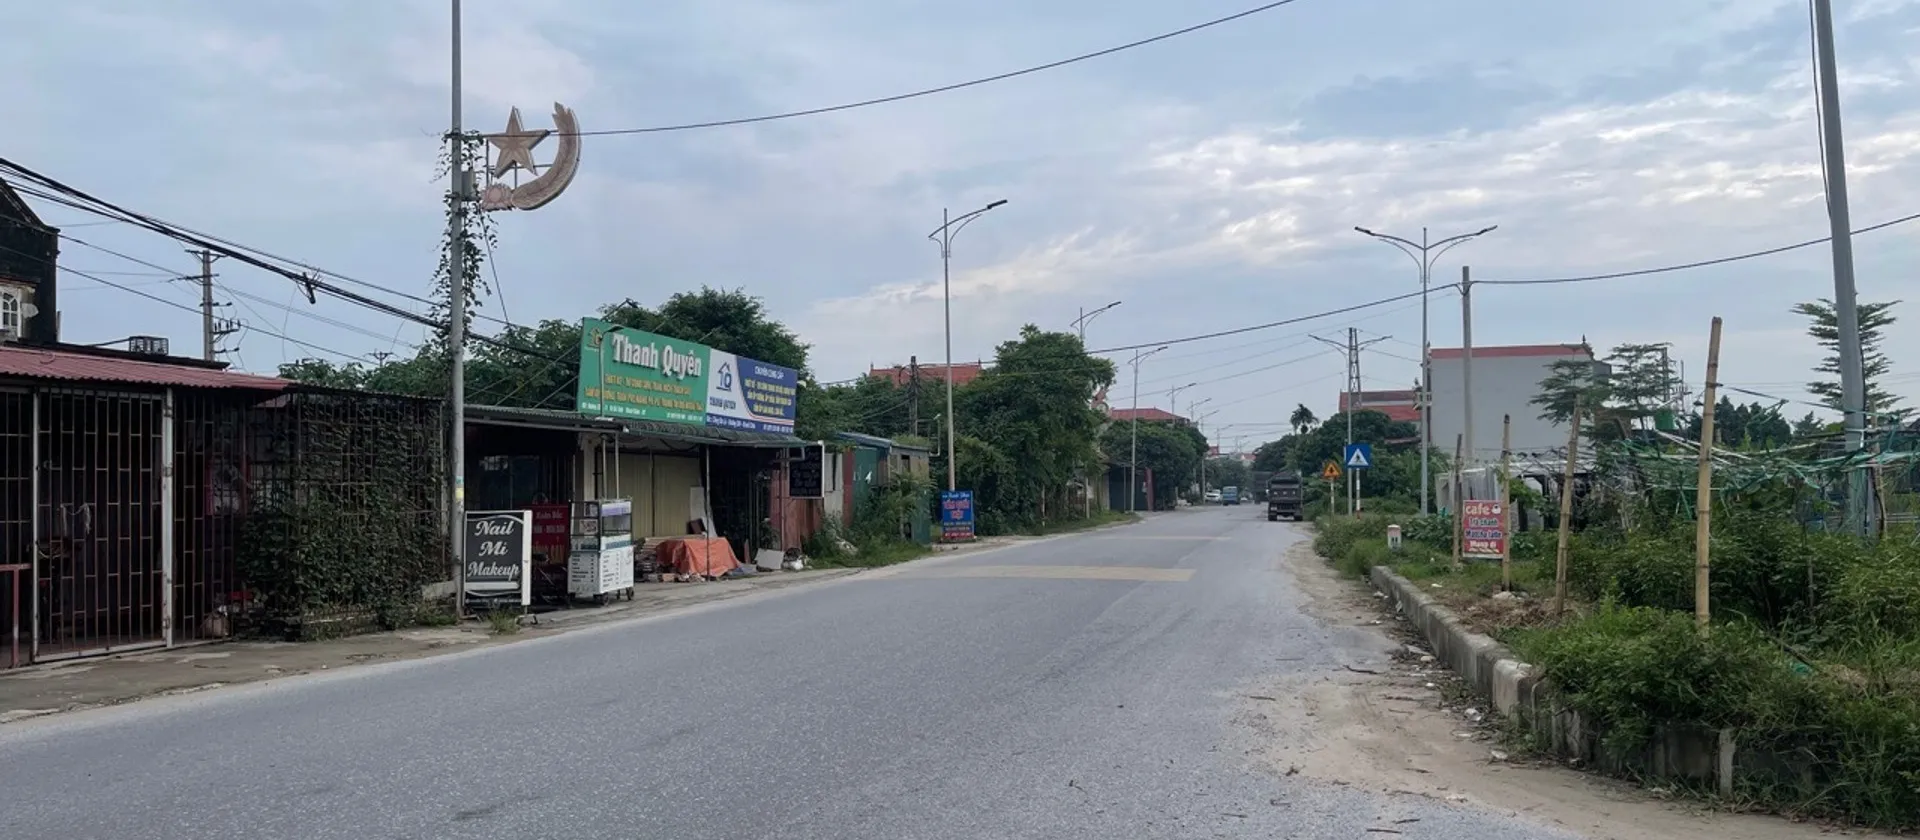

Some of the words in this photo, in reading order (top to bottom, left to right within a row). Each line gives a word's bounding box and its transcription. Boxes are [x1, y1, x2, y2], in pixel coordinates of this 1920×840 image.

[612, 332, 659, 369] Thanh
[1465, 502, 1490, 516] cafe
[474, 520, 514, 536] Nail
[478, 540, 508, 557] Mi
[467, 560, 520, 582] Makeup
